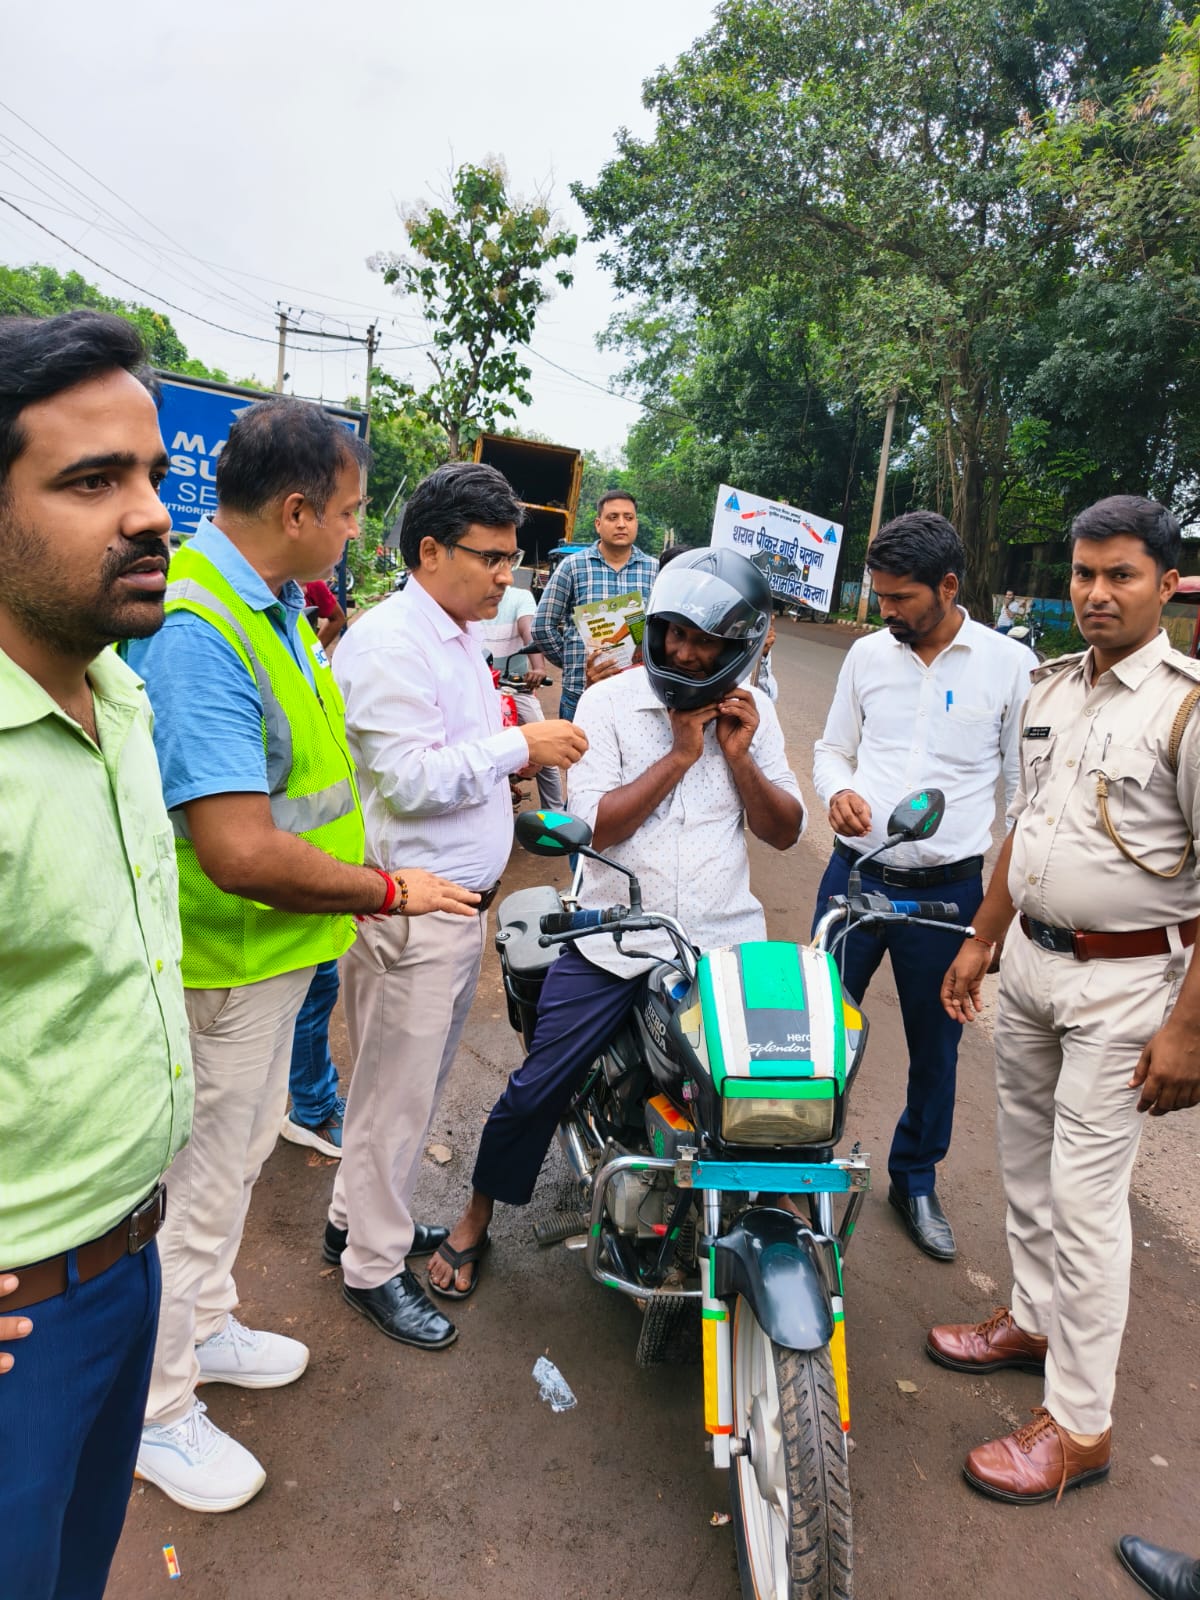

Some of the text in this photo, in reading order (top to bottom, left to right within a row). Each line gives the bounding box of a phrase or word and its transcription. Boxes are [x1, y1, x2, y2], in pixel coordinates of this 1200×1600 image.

[756, 526, 780, 553] पीकर
[779, 537, 799, 562] गाड़ी
[799, 546, 824, 569] चलाना
[647, 1000, 666, 1036] HERO
